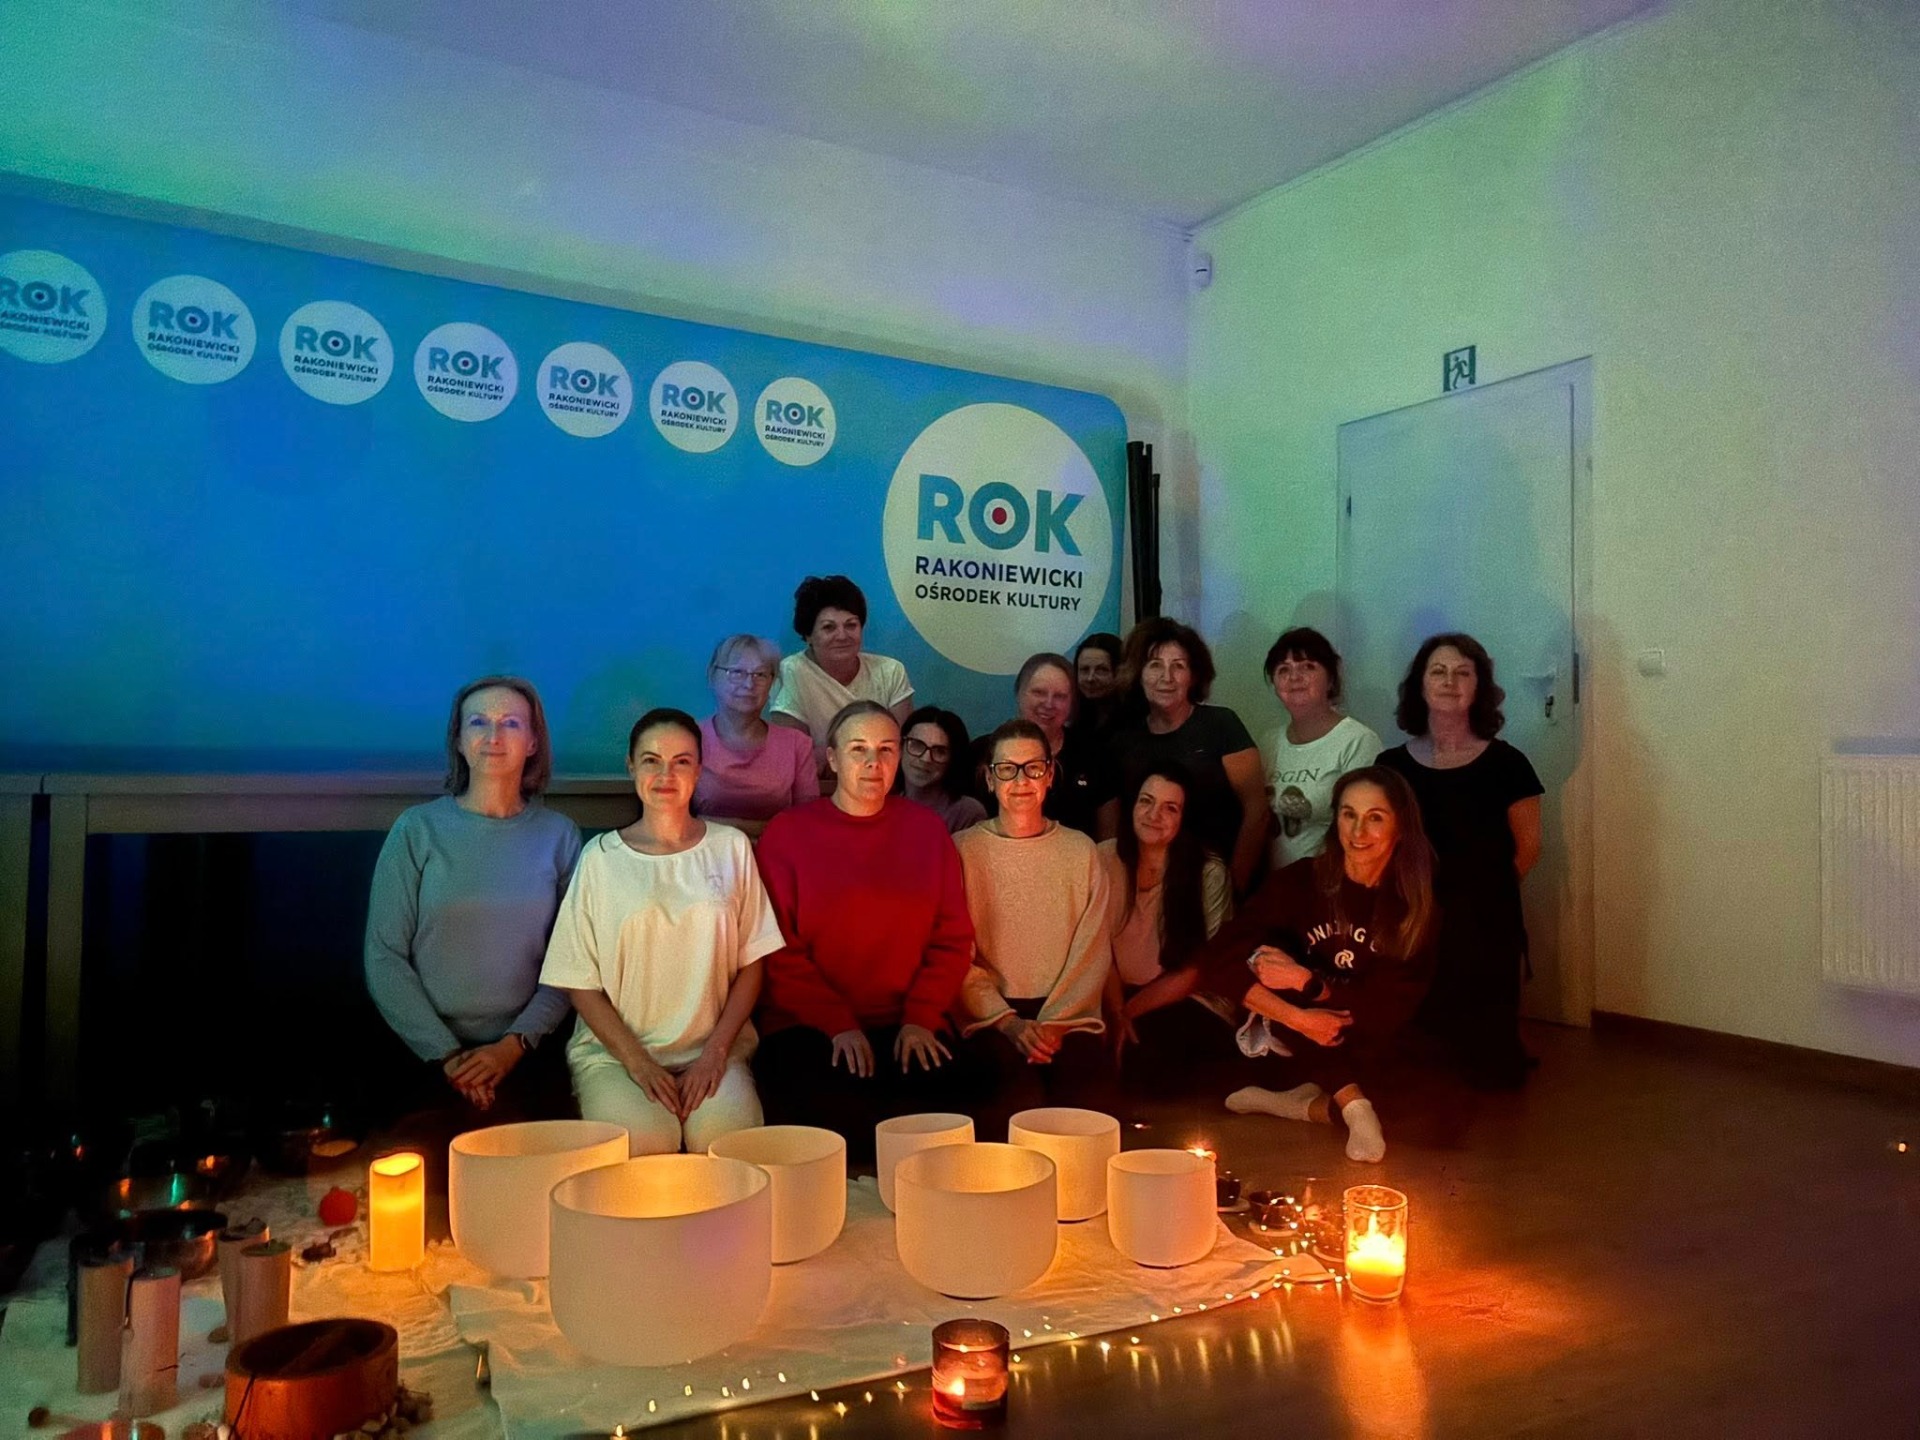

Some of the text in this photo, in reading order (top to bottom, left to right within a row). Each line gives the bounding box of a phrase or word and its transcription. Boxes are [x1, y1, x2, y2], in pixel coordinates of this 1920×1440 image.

[0, 311, 90, 331] AKONIEWICKI
[149, 301, 240, 340] ROK
[147, 332, 240, 354] RAKONIEWICKI
[147, 343, 239, 363] OŚRODEK KULTURY
[295, 325, 379, 362] ROK
[294, 354, 379, 375] RAKONIEWICKI
[294, 365, 377, 383] OŚRODEK KULTURY
[428, 347, 504, 381] ROK
[427, 375, 504, 393] RAKONIEWICKI
[550, 365, 620, 398] ROK
[427, 384, 504, 402] OŚRODEK KULTURY
[548, 393, 620, 410] RAKONIEWICKI
[662, 384, 727, 414] ROK
[548, 402, 619, 418] OŚRODEK KULTURY
[661, 409, 727, 426] RAKONIEWICKI
[766, 399, 825, 429] ROK
[661, 418, 726, 434] OŚRODEK KULTURY
[765, 425, 826, 440] RAKONIEWICKI
[765, 433, 825, 448] OŚRODEK KULTURY
[917, 473, 1085, 557] ROK
[915, 555, 1083, 589] RAKONIEWICKI
[915, 582, 1081, 611] OŚRODEK KULTURY
